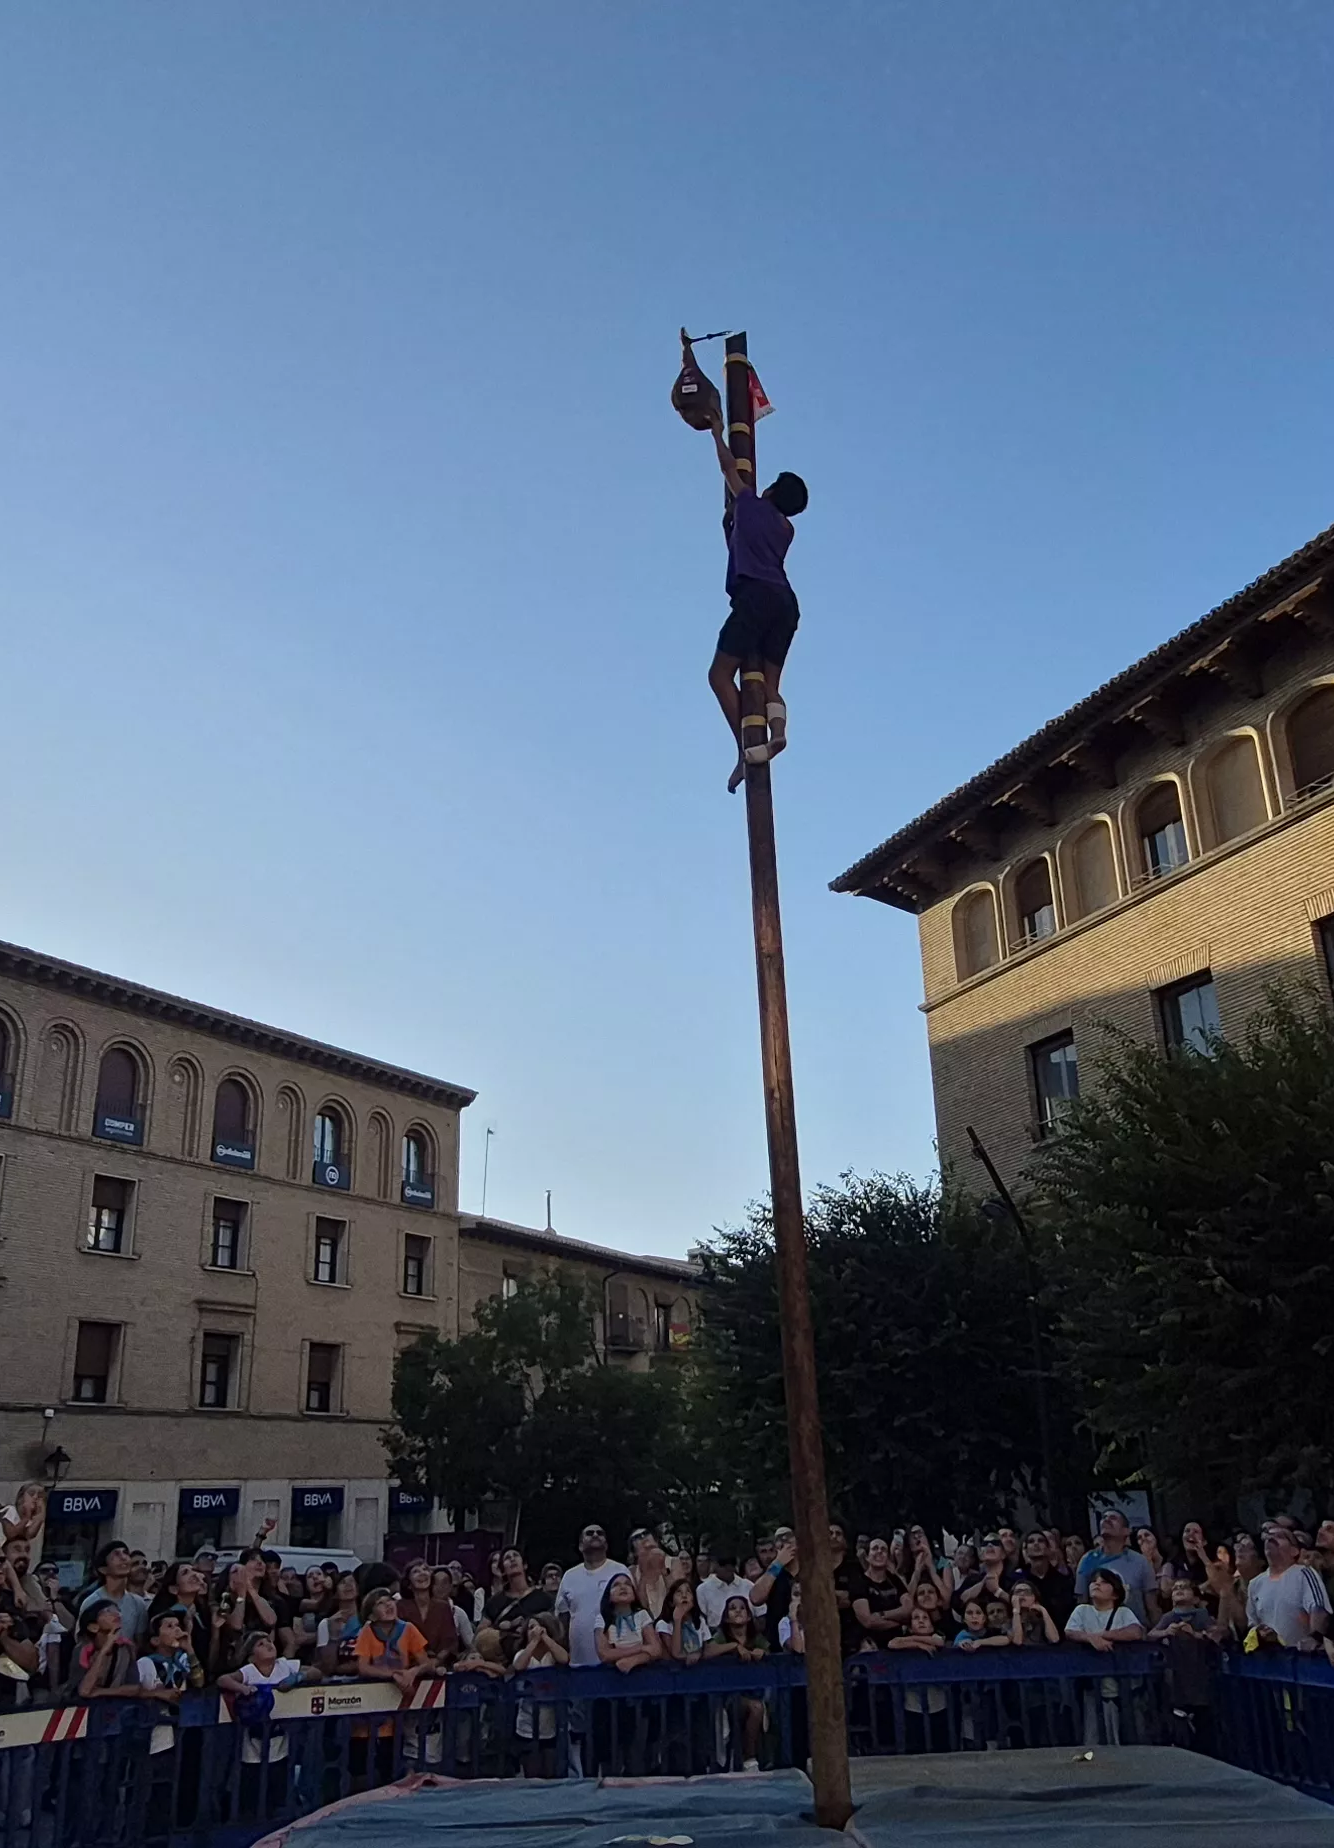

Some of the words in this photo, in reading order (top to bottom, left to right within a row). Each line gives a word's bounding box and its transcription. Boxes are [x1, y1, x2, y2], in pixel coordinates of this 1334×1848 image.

[62, 1496, 102, 1512] BBVA
[192, 1493, 227, 1509] BBVA
[303, 1492, 333, 1507] BBVA
